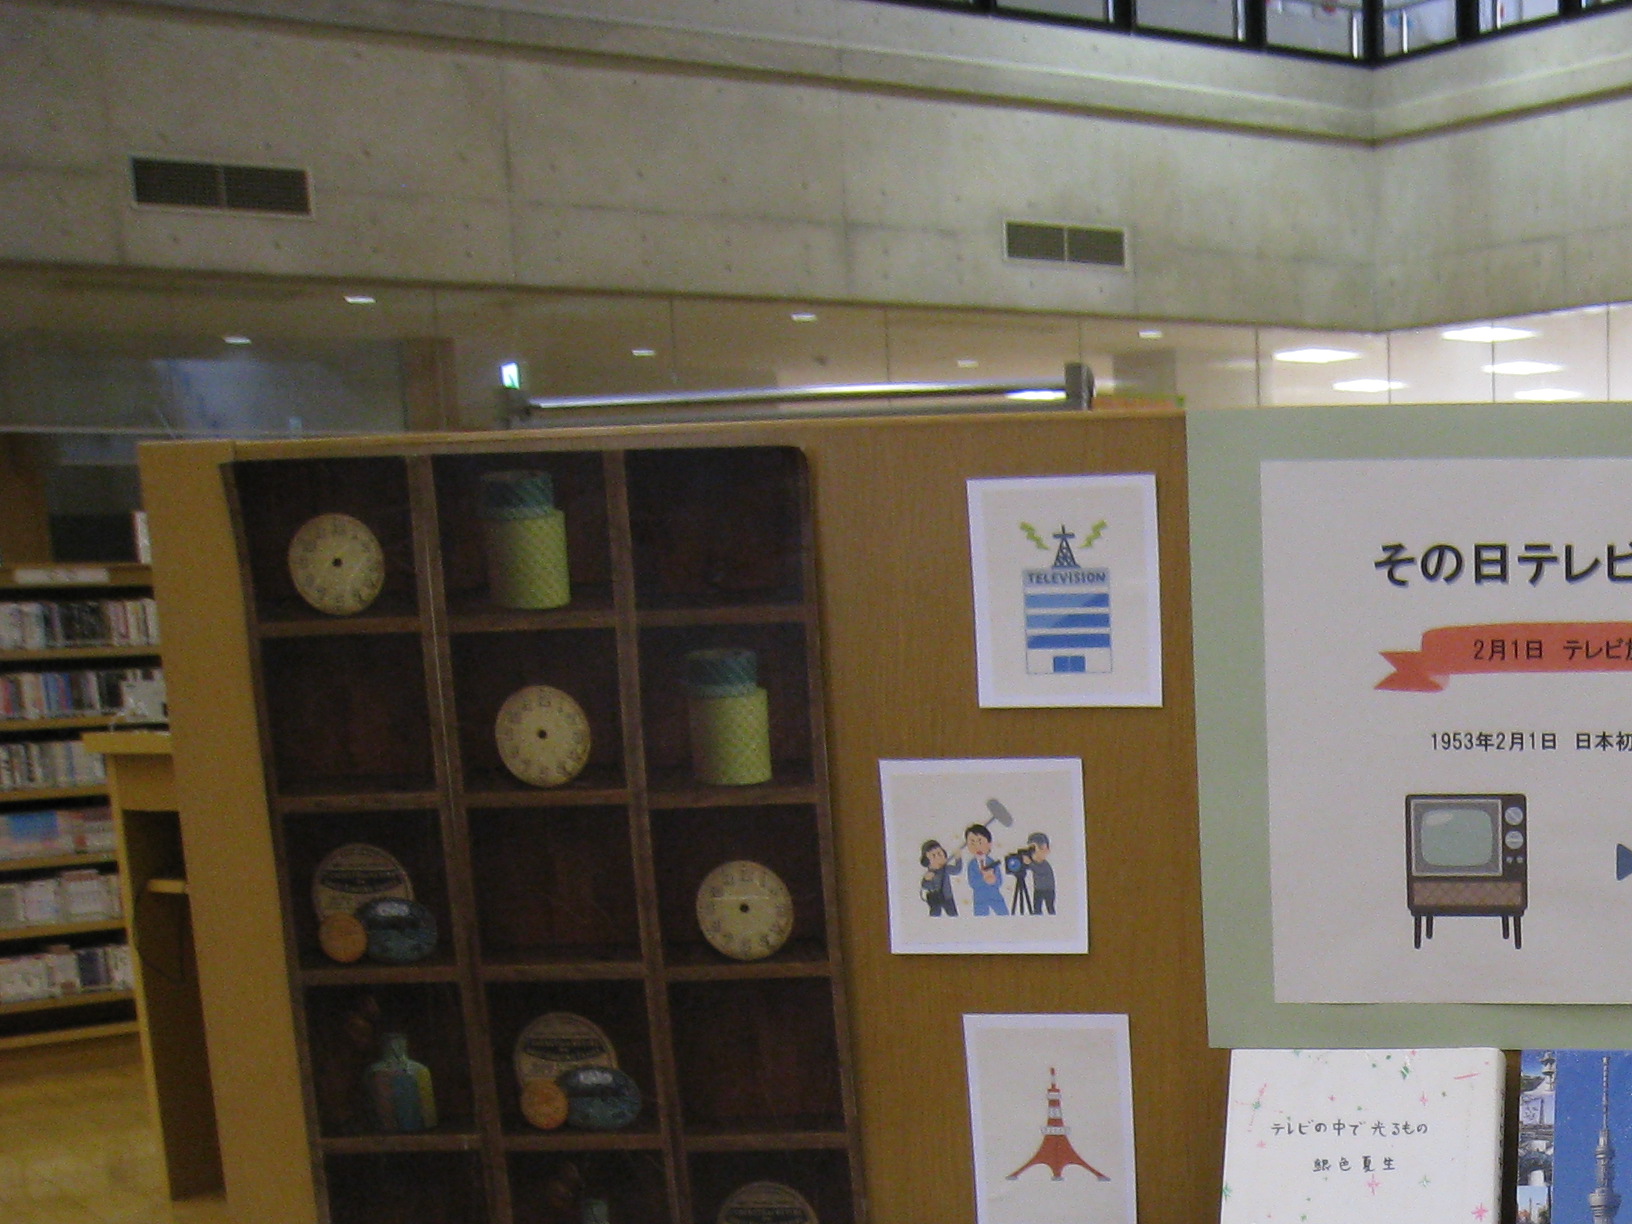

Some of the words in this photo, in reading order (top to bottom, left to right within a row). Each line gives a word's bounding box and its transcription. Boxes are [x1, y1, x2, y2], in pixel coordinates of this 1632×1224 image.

[1026, 571, 1107, 585] TELEVISION
[1473, 637, 1545, 662] 2月1日
[1429, 731, 1558, 754] 1953年2月1日
[1270, 1118, 1430, 1140] テレビの中で光るもの
